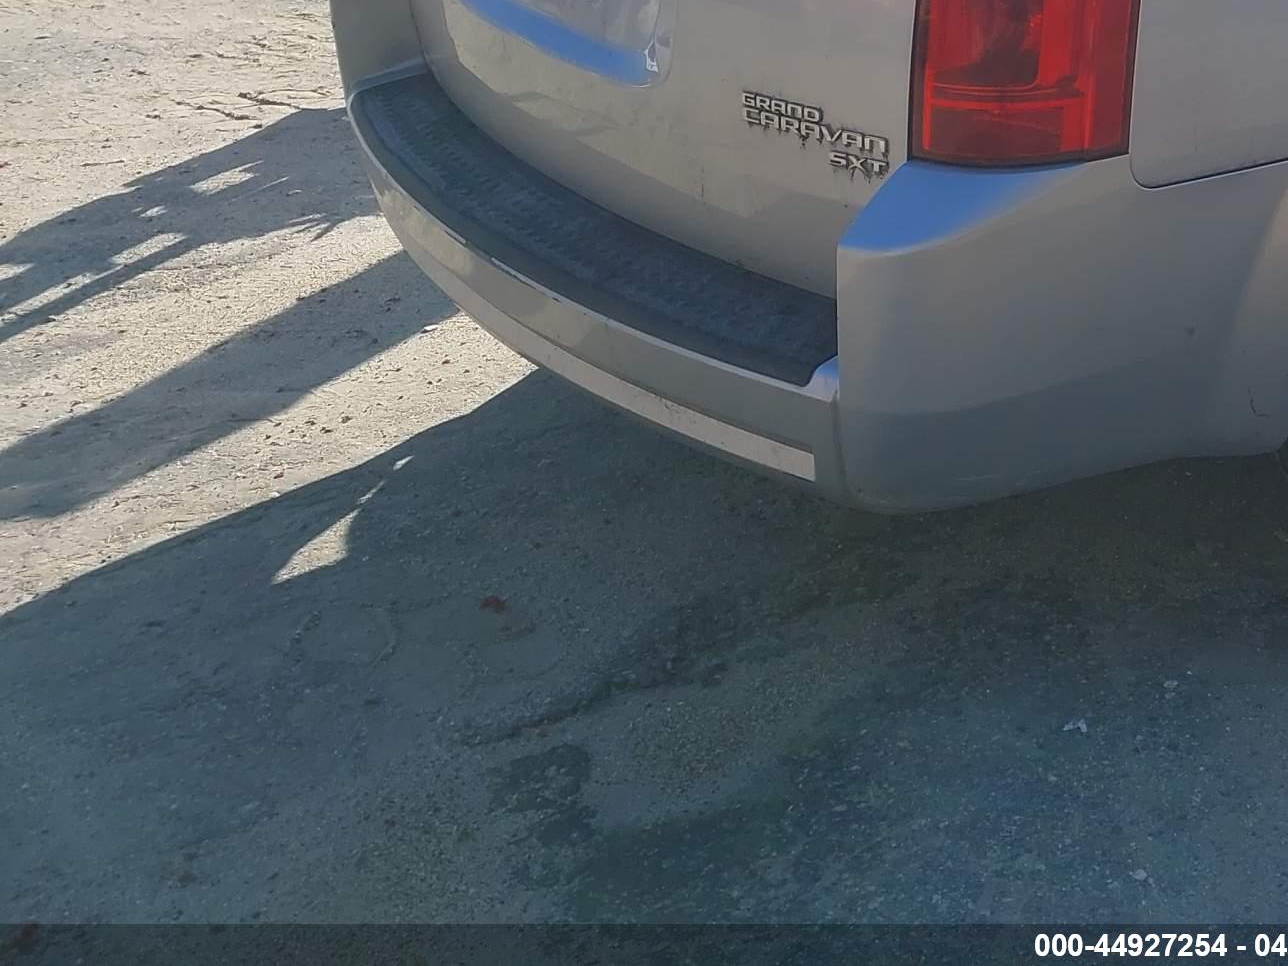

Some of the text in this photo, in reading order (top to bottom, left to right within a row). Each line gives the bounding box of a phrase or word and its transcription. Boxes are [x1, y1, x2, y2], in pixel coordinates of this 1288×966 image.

[742, 91, 821, 122] GRAND
[743, 108, 888, 153] CARAVAN
[829, 151, 888, 173] SXT
